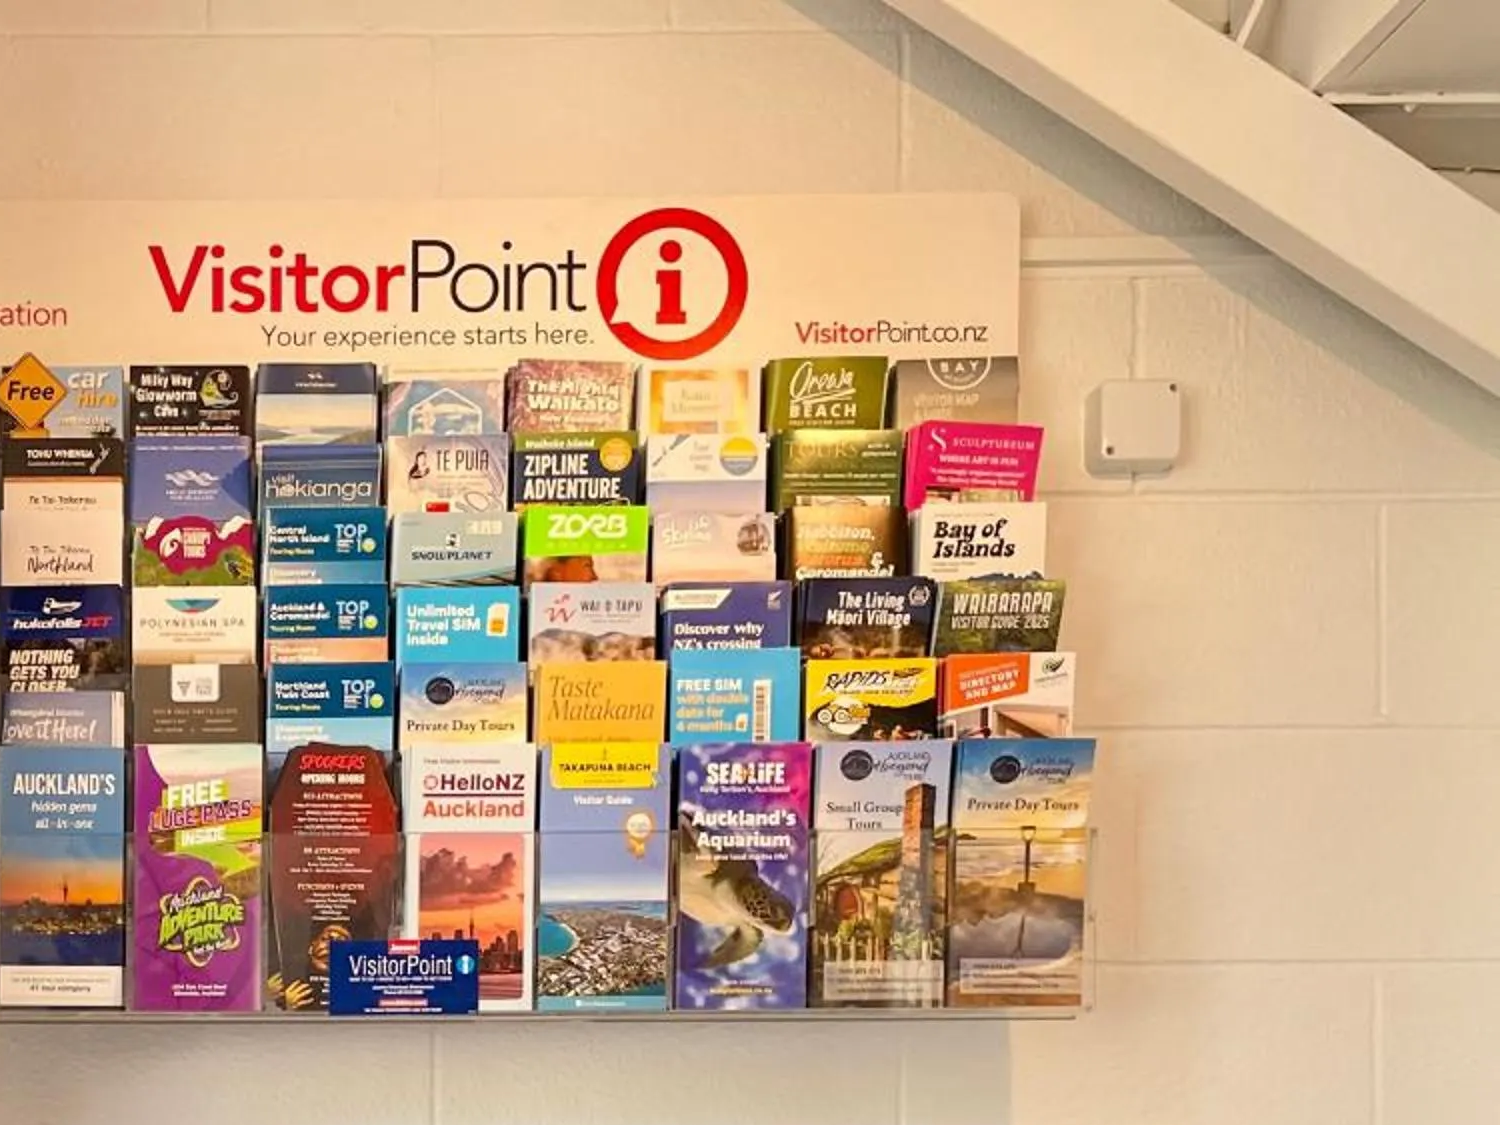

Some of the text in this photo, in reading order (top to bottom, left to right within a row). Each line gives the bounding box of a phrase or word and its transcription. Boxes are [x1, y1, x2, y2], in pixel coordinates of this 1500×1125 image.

[148, 239, 587, 314] VisitorPoint
[261, 323, 595, 353] Your experience starts here.
[794, 319, 989, 345] VisitorPoint.co.nz
[939, 360, 980, 374] BAY
[67, 371, 109, 389] car
[141, 373, 194, 389] Milky Way
[7, 380, 55, 401] Free
[135, 387, 198, 403] Glowworm
[153, 404, 180, 418] Cave
[789, 402, 857, 418] BEACH
[435, 449, 490, 472] TE PUIA
[523, 453, 590, 477] ZIPLINE
[523, 477, 621, 501] ADVENTURE
[269, 525, 307, 535] Central
[335, 523, 368, 539] TOP
[547, 514, 628, 539] ZORB
[933, 518, 1008, 541] Bay of
[269, 534, 330, 544] North Island
[932, 539, 1016, 559] Islands
[26, 554, 95, 575] Northland
[795, 565, 895, 580] Coromandel
[270, 603, 318, 612] Auckland
[336, 600, 369, 615] TOP
[838, 591, 906, 612] The Living
[953, 591, 1053, 616] WAIRARAPA
[270, 612, 331, 621] Coromandel
[406, 604, 475, 617] Unlimited
[866, 608, 911, 629] Village
[140, 617, 246, 629] POLYNESIAN SPA
[406, 617, 481, 632] Travel SIM
[674, 621, 765, 637] Discover why
[951, 614, 989, 630] VISITOR
[1022, 614, 1050, 629] 2025
[406, 633, 449, 646] Inside
[674, 637, 762, 649] NZ's crossing
[9, 649, 75, 666] NOTHING
[9, 665, 80, 682] GETS YOU
[959, 669, 1020, 691] DIRECTORY
[274, 681, 327, 691] Northland
[341, 679, 376, 695] TOP
[548, 676, 604, 699] Taste
[676, 678, 743, 692] FREE SIM
[274, 690, 331, 700] Twin Coast
[964, 687, 990, 700] AND
[547, 698, 655, 722] Matakana
[706, 706, 724, 718] for
[406, 719, 516, 735] Private Day Tours
[299, 754, 366, 771] SPOOKERS
[559, 763, 651, 773] TAKAPUNA BEACH
[706, 762, 743, 785] SEA
[13, 773, 116, 795] AUCKLAND'S
[441, 773, 525, 791] HelloNZ
[165, 779, 225, 808] FREE
[573, 795, 633, 805] Visitor Guide
[31, 801, 97, 815] hidden gems
[423, 800, 525, 818] Auckland
[827, 801, 903, 816] Small Group
[967, 798, 1079, 814] Private Day Tours
[148, 799, 253, 833] LUGE PASS
[692, 809, 797, 827] Auckland's
[846, 818, 882, 830] Tours
[697, 831, 791, 851] Aquarium
[160, 901, 244, 944] ADVENTURE
[184, 923, 225, 949] PARK
[348, 954, 453, 977] VisitorPoint
